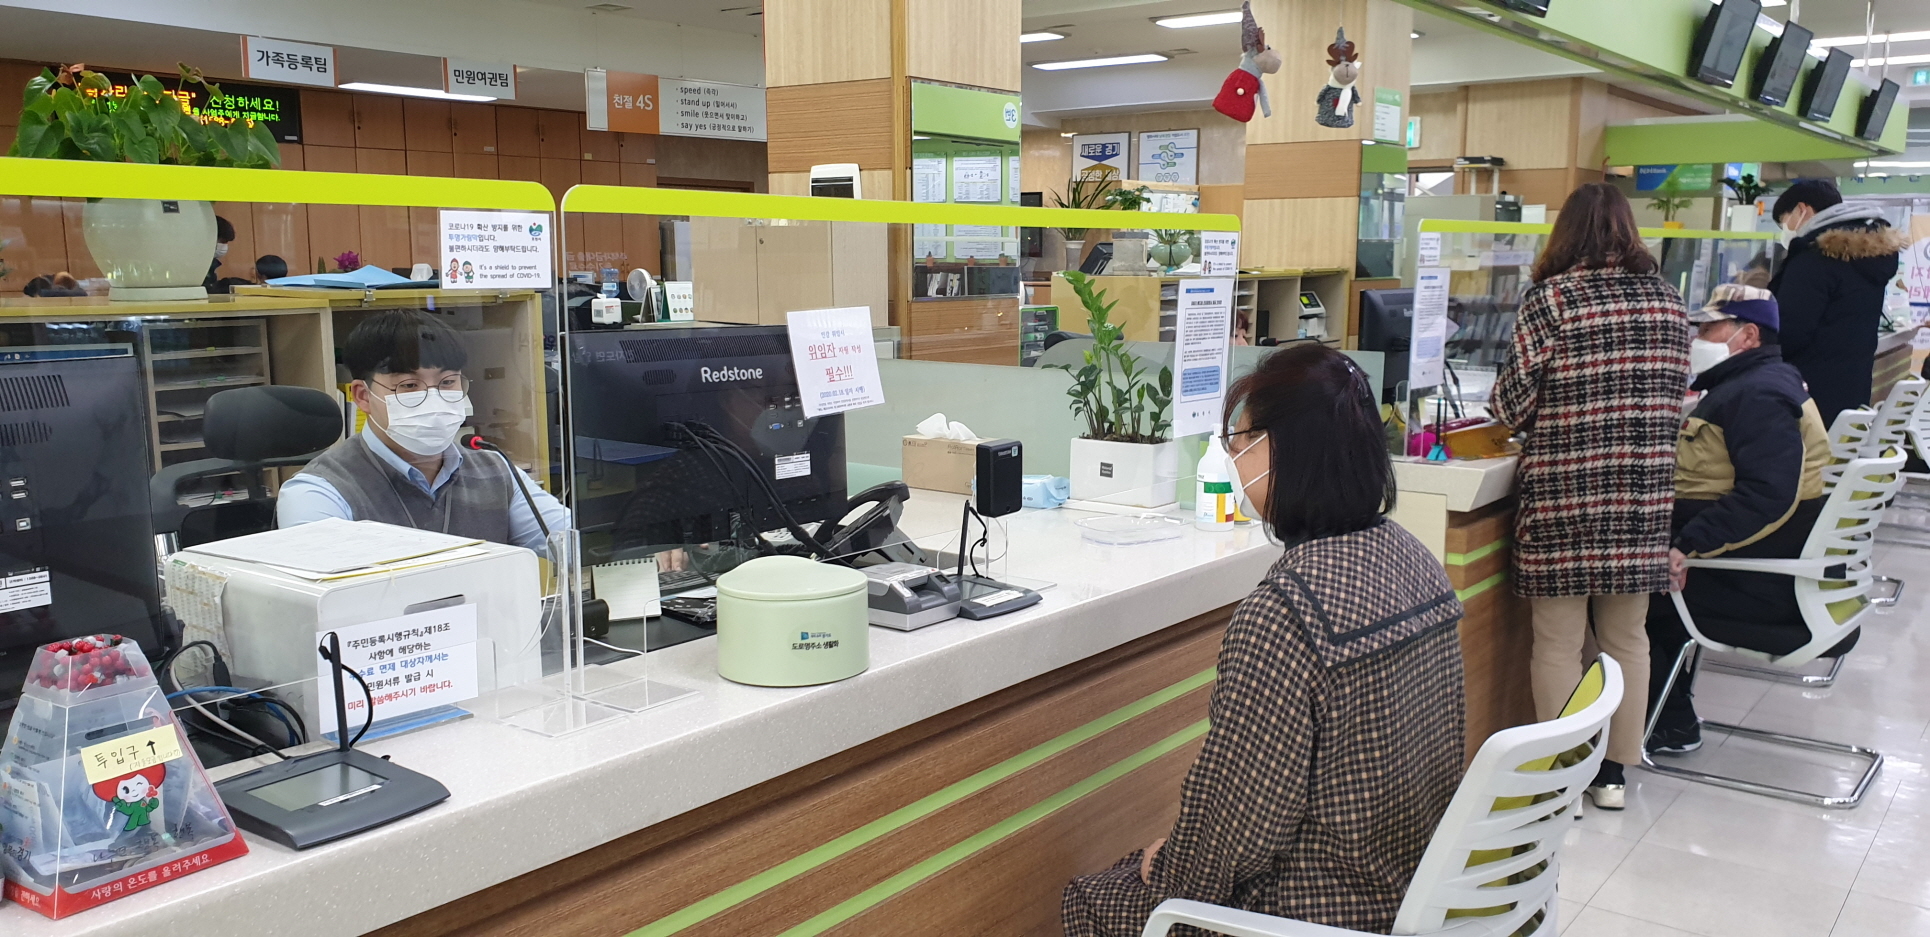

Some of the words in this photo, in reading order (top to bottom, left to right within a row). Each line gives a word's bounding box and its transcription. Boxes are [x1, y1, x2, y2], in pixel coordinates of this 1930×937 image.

[256, 49, 327, 73] 가족등록팀
[453, 68, 509, 88] 민원여권팀
[680, 87, 701, 95] speed
[613, 94, 633, 109] 친절
[636, 94, 653, 111] 4S
[680, 98, 700, 107] stand
[702, 101, 711, 109] up
[680, 109, 700, 118] smile
[702, 110, 725, 120] (웃으면서
[681, 122, 693, 131] say
[694, 123, 707, 131] yes
[1081, 144, 1103, 156] 새로운
[1105, 143, 1120, 155] 경기
[448, 223, 474, 231] 코로나19
[476, 223, 489, 231] 확산
[491, 224, 509, 232] 방지를
[511, 224, 523, 232] 위한
[448, 244, 491, 253] 불편하시더라도
[492, 245, 540, 253] 양해부탁드립니다.
[479, 263, 488, 271] It's
[518, 264, 538, 272] prevent
[808, 342, 838, 360] 위임자
[700, 366, 763, 384] Redstone
[825, 365, 854, 383] 필수!!!
[368, 649, 394, 661] 사항에
[398, 641, 432, 656] 해당하는
[792, 642, 822, 650] 도로명주소
[379, 662, 396, 675] 면제
[400, 652, 449, 670] 대상자께서는
[367, 676, 401, 692] 민원서류
[405, 671, 421, 683] 발급
[425, 668, 434, 678] 시
[347, 698, 365, 711] 미리
[420, 679, 454, 695] 바랍니다.
[94, 745, 140, 769] 투입구
[90, 881, 124, 901] 사랑의
[126, 869, 158, 891] 온도를
[161, 852, 213, 878] 올려주세요.
